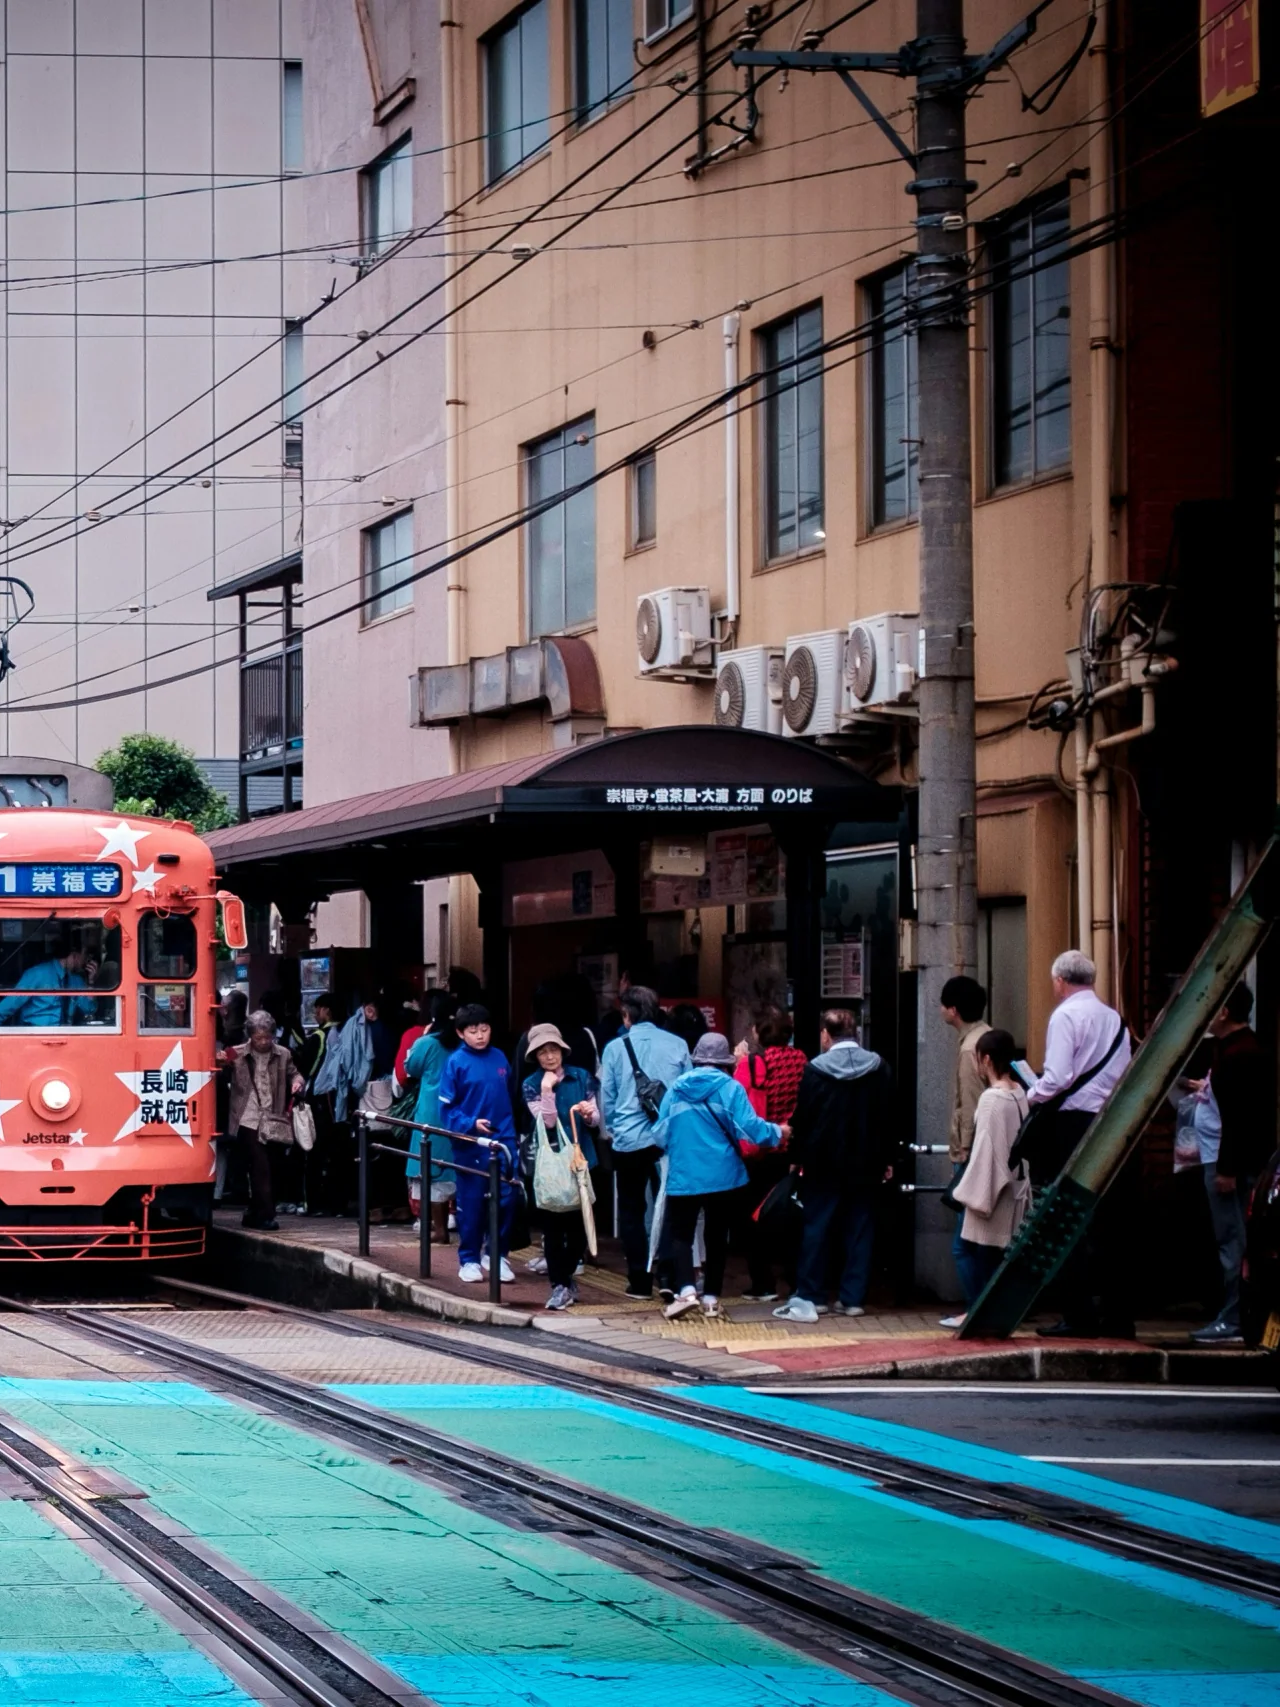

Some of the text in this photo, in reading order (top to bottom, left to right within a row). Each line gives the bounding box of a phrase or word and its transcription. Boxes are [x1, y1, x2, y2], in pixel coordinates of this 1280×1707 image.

[737, 788, 764, 803] 方面
[772, 788, 813, 803] のりば
[32, 871, 118, 893] 崇福寺
[141, 1069, 189, 1093] 長崎
[141, 1099, 197, 1124] 就航!
[23, 1132, 71, 1144] Jetstar
